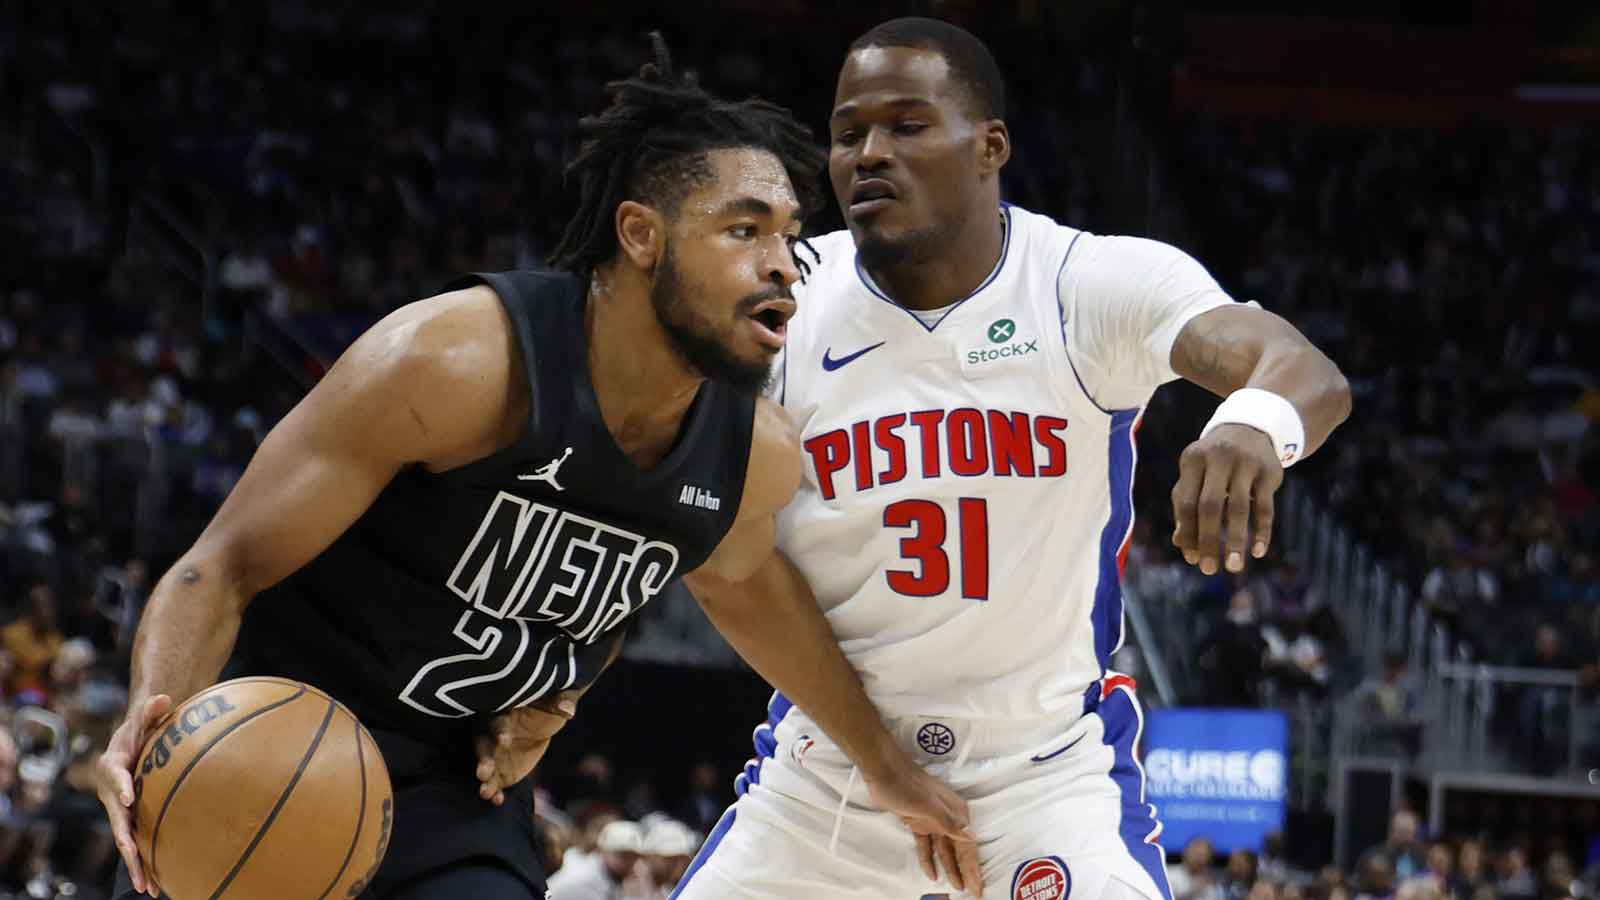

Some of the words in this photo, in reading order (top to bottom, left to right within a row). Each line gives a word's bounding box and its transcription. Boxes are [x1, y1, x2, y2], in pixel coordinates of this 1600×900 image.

[967, 339, 1038, 364] StockX
[803, 408, 1068, 500] PISTONS
[446, 490, 679, 645] NETS
[883, 497, 989, 600] 31
[1020, 872, 1057, 897] DETROIT
